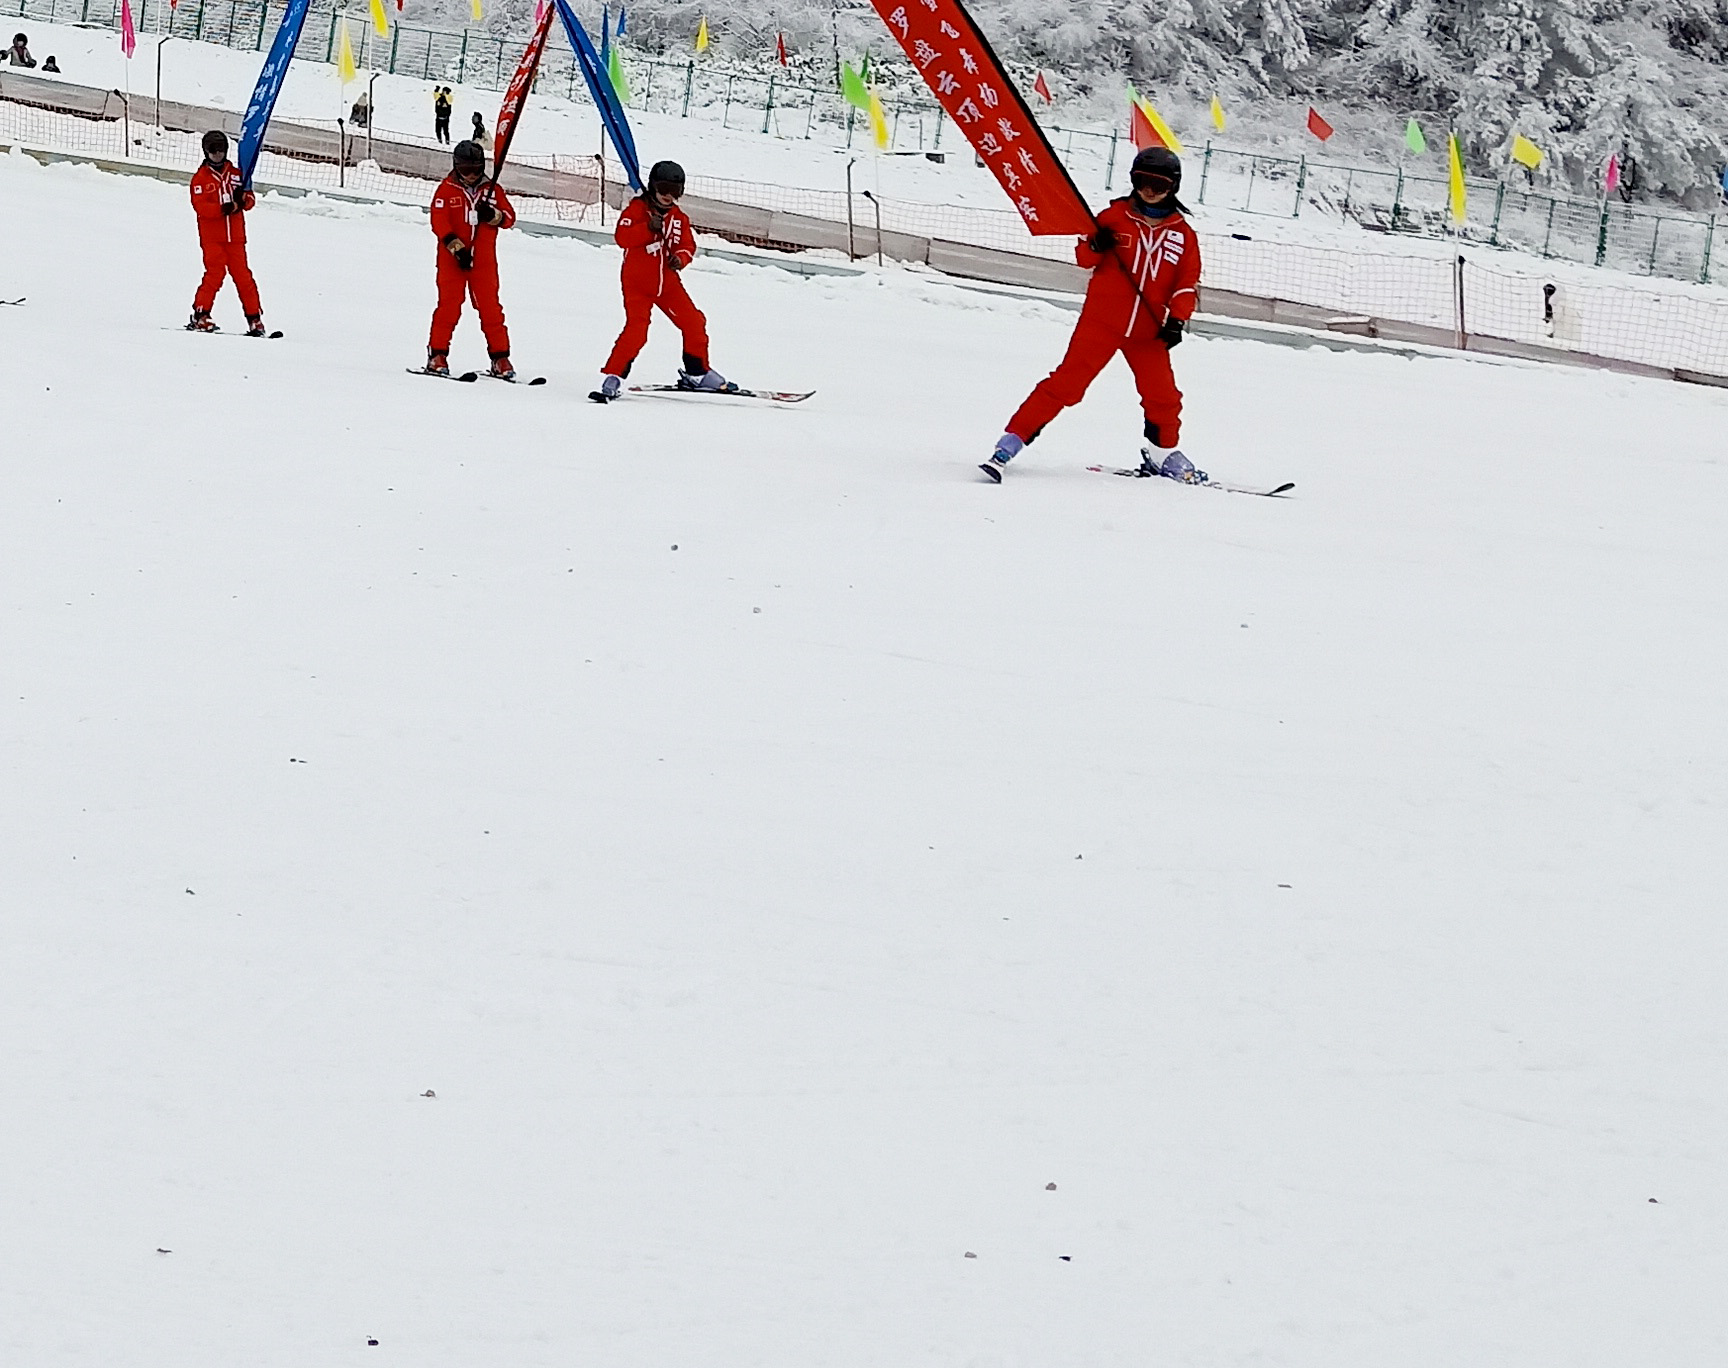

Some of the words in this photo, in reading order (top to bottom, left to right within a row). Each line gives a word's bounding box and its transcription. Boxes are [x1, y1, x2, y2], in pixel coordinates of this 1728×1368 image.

[889, 6, 1040, 223] 罗盘云顶迎宾客
